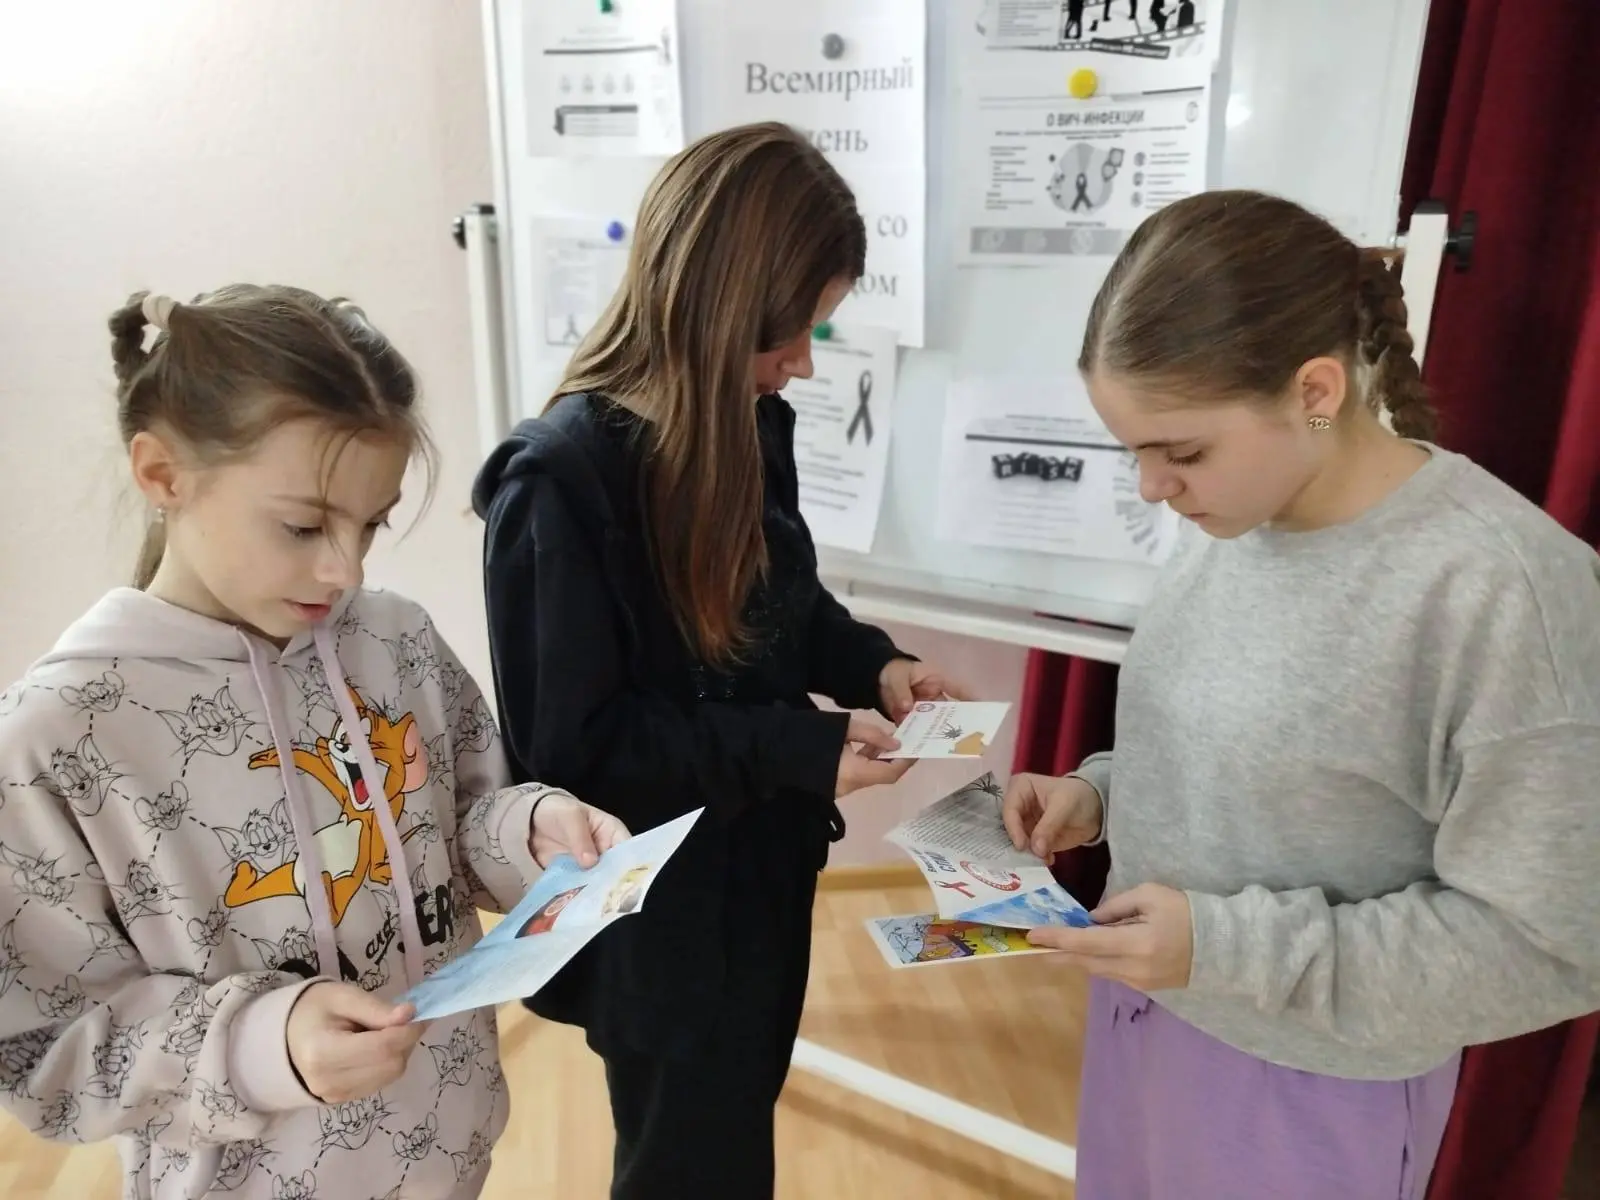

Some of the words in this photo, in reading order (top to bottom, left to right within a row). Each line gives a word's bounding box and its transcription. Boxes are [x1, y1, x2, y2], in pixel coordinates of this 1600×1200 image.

[746, 57, 913, 101] Всемирный
[876, 215, 908, 238] со
[852, 272, 897, 298] ом
[366, 911, 396, 960] and
